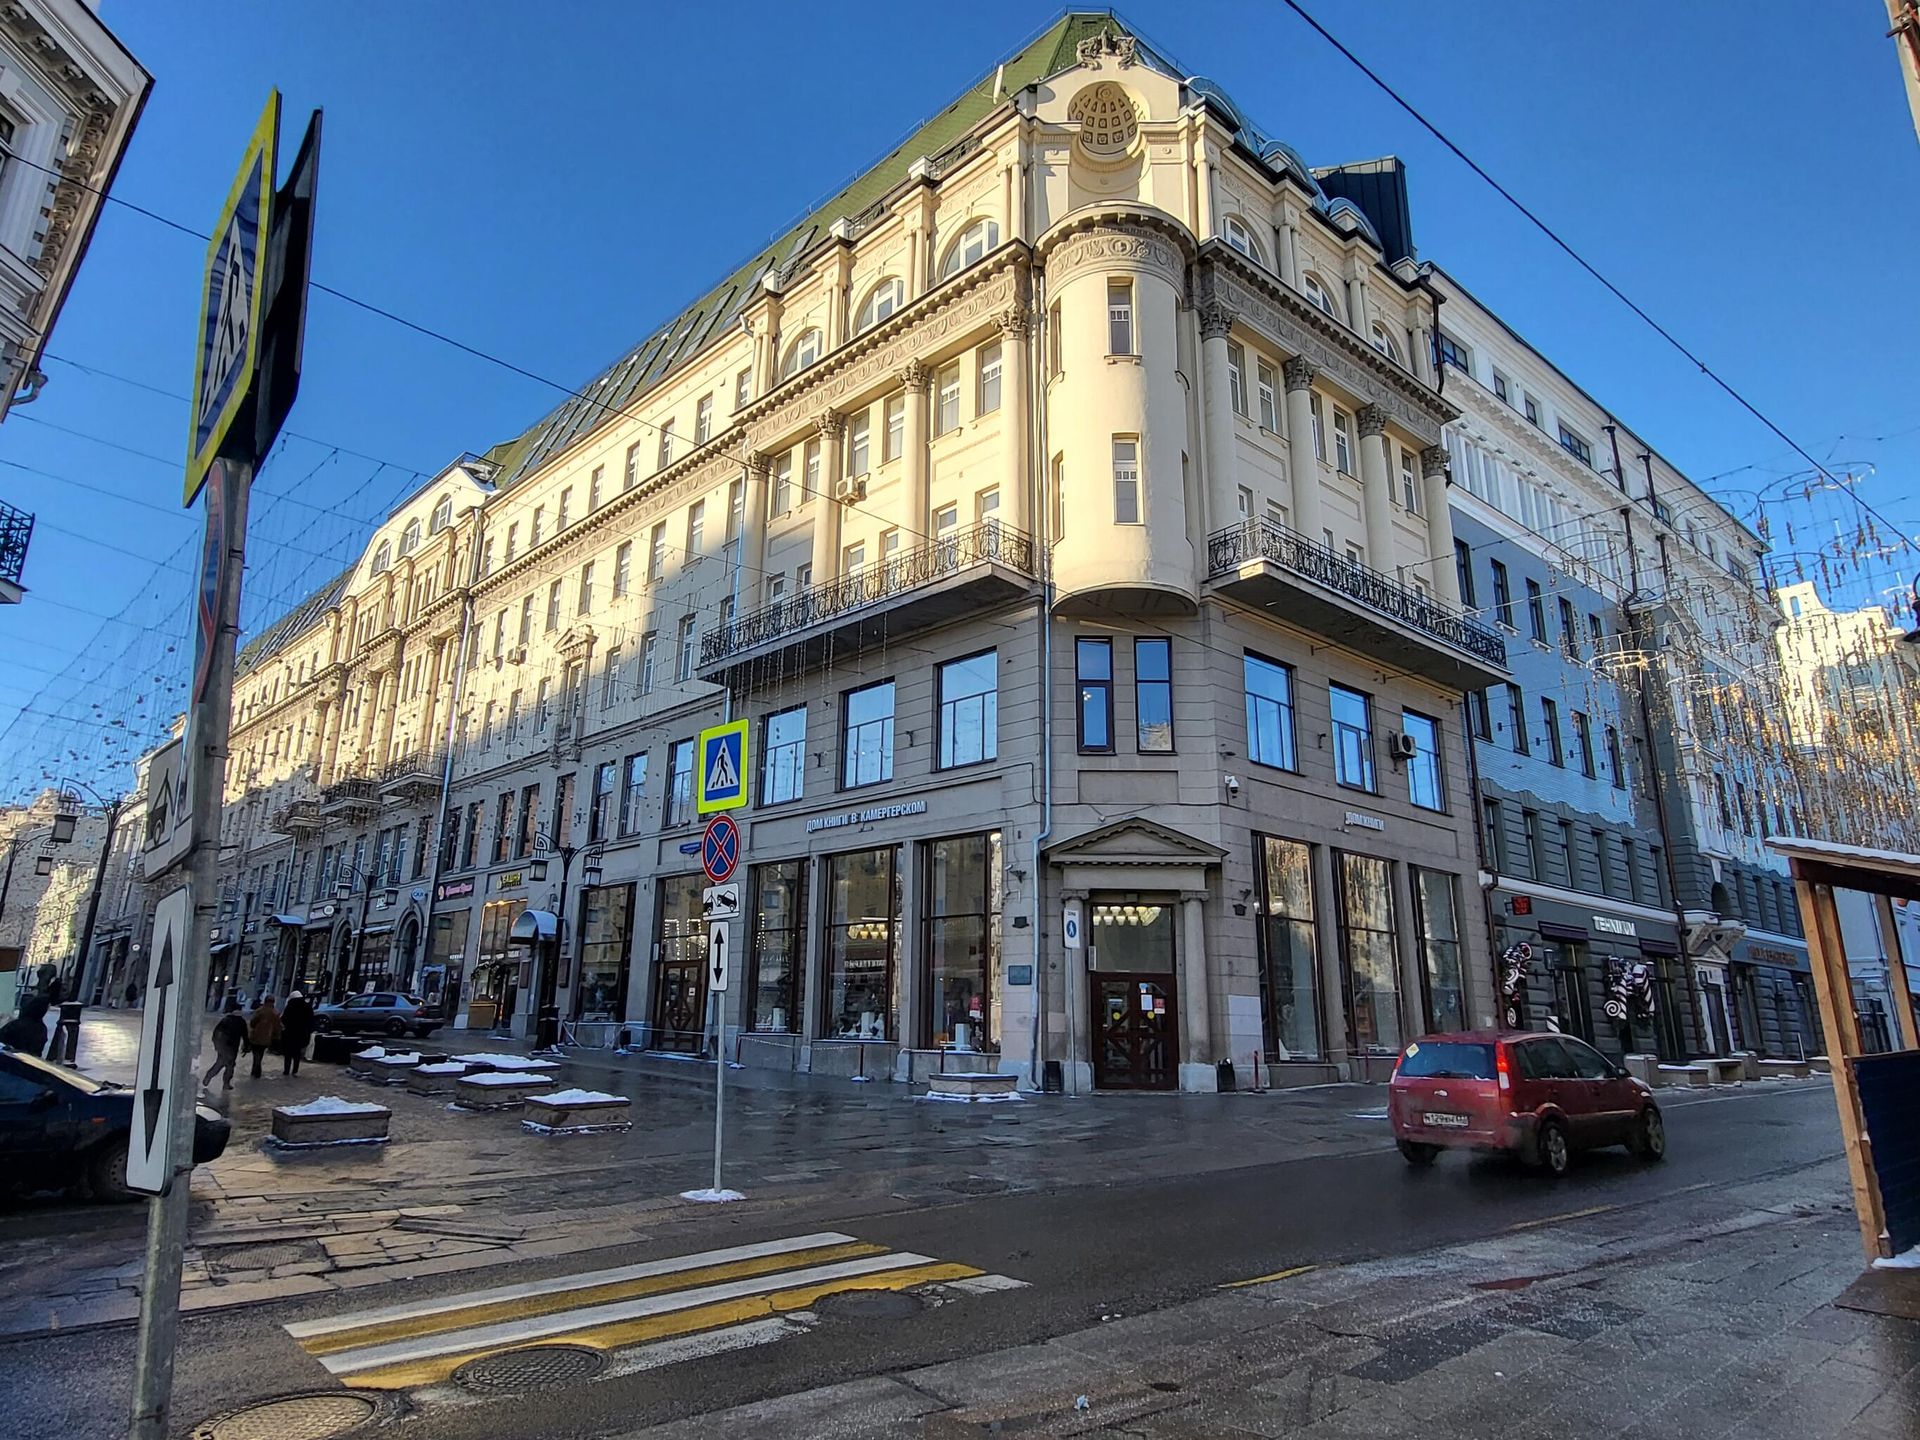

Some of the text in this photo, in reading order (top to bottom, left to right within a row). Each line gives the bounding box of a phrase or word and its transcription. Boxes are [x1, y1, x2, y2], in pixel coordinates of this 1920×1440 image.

[806, 801, 928, 833] ДОМ КНИГИ В КАМЕРГЕРСКОМ
